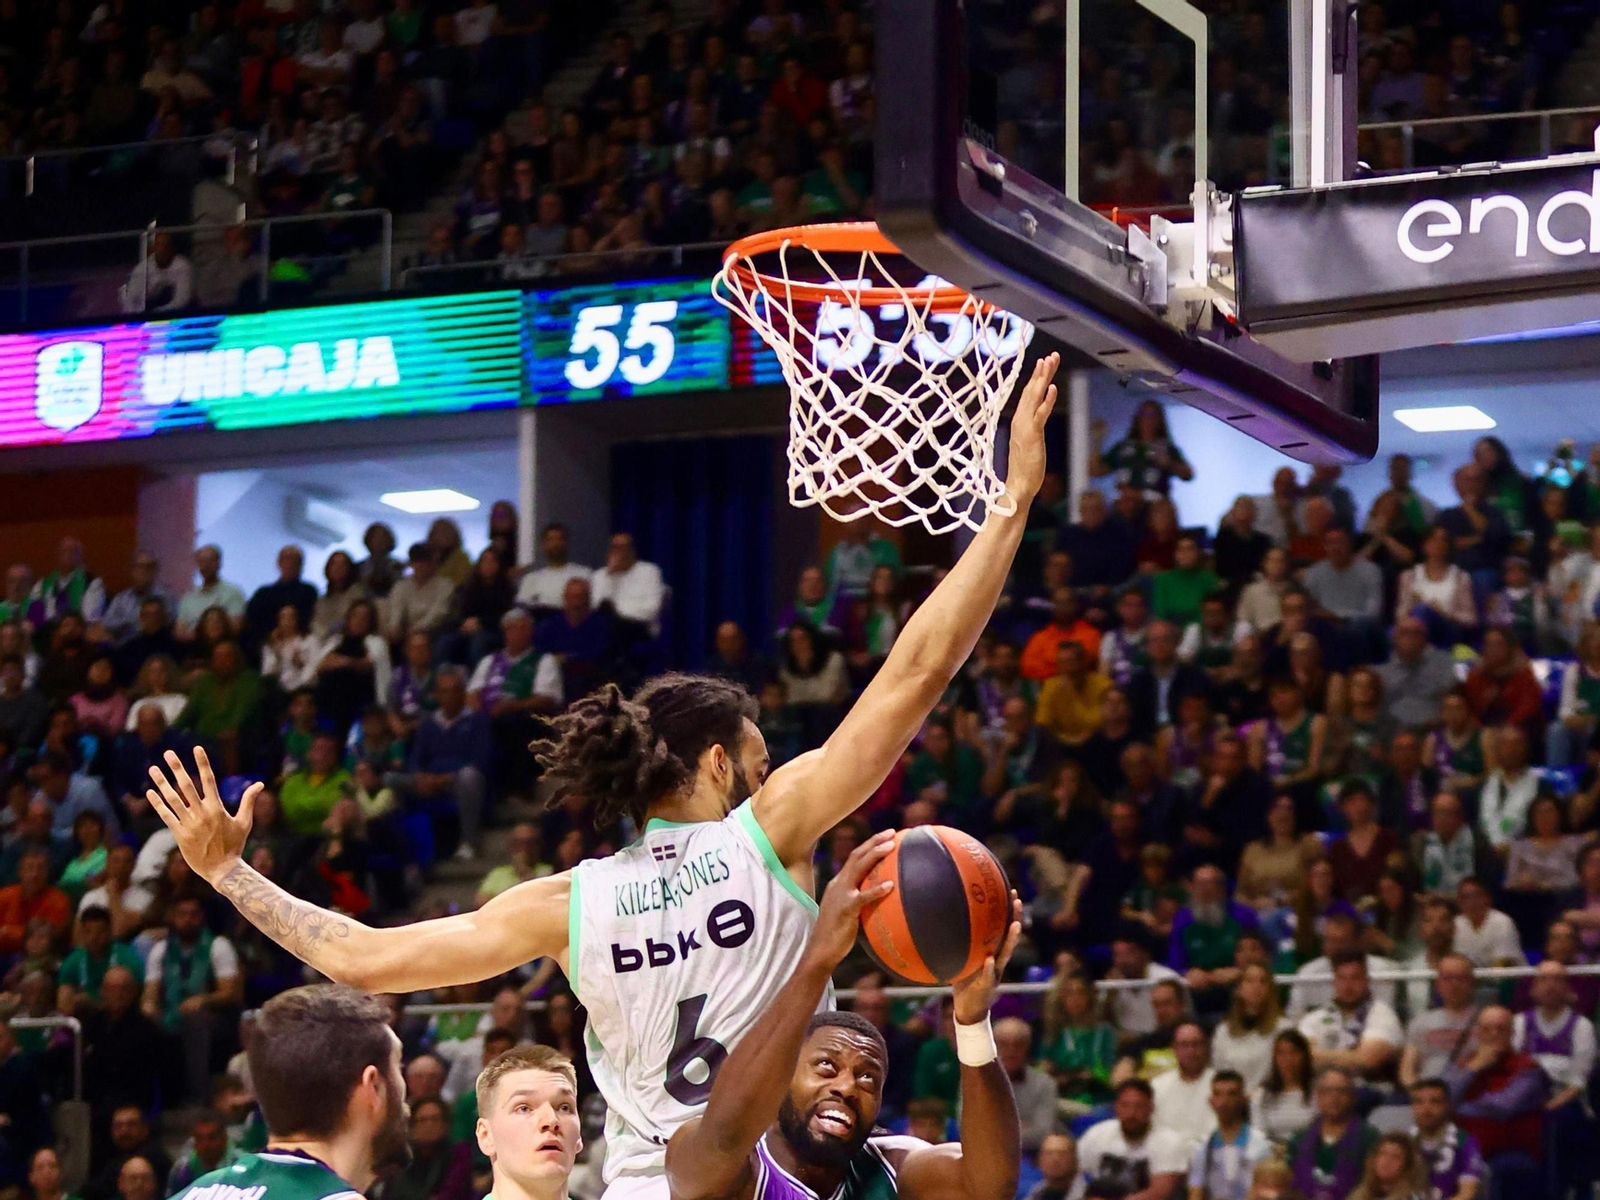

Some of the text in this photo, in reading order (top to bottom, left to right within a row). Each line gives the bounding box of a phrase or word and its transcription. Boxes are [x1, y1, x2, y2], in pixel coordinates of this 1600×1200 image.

[141, 336, 400, 405] UNICAJA
[564, 301, 678, 389] 55
[611, 927, 702, 973] bbk
[664, 993, 728, 1106] 6
